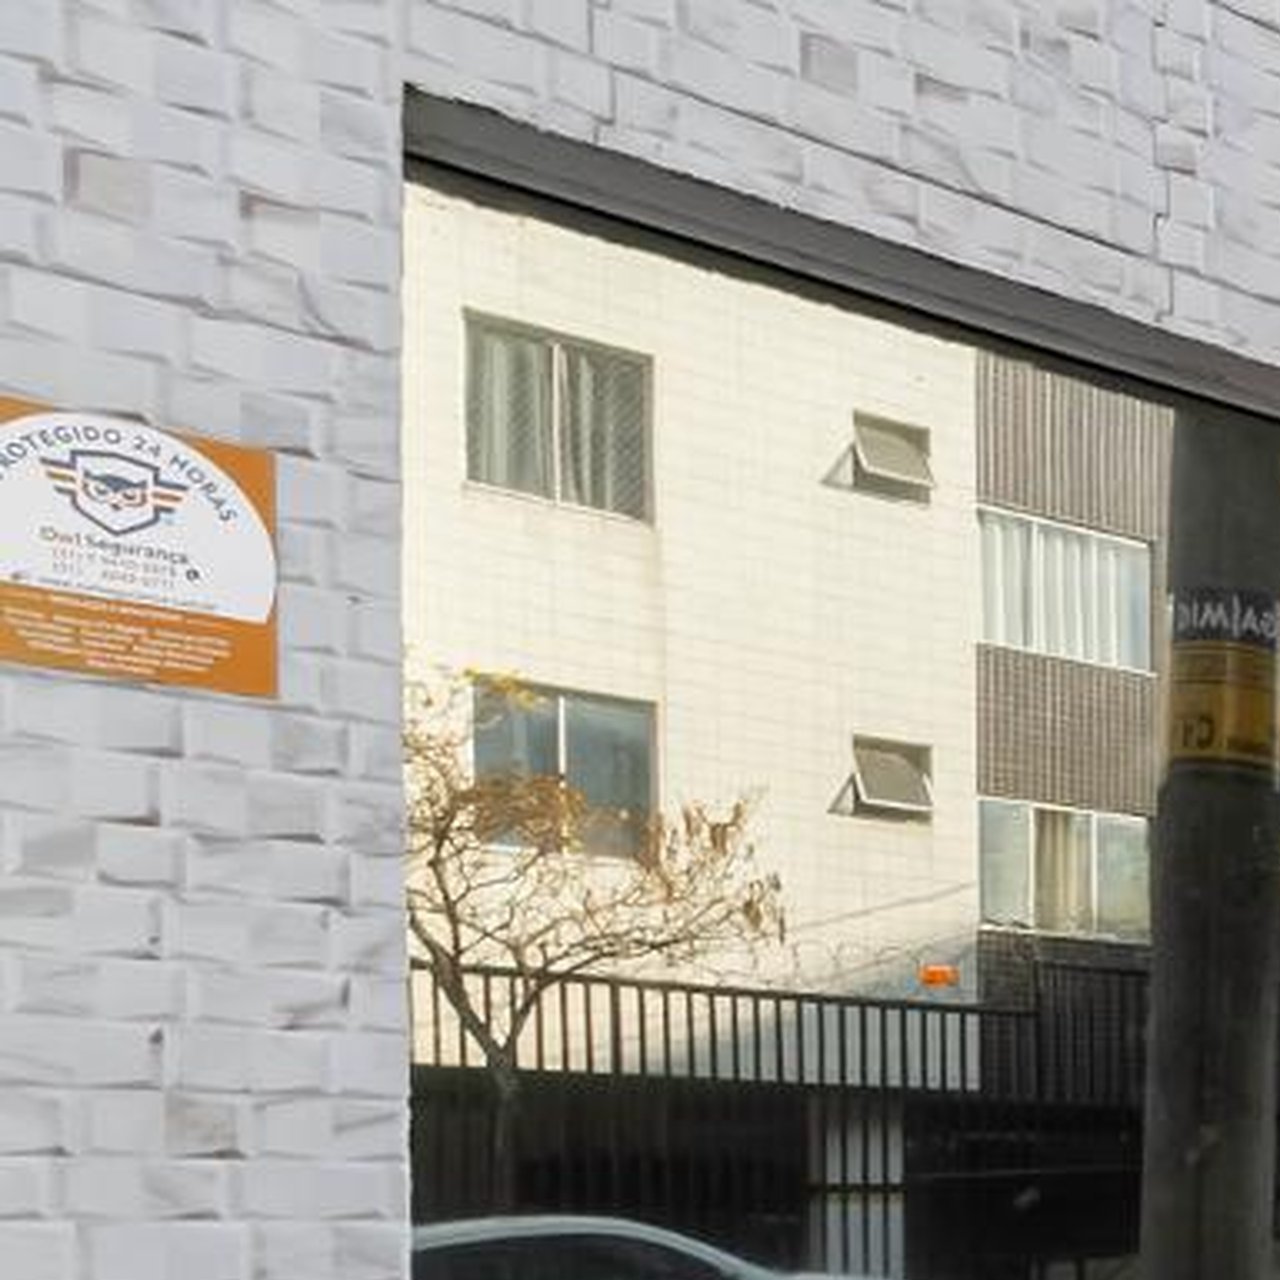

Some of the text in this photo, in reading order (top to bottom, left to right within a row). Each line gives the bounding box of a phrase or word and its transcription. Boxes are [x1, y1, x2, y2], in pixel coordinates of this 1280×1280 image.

[0, 425, 239, 523] ROTEGIDO 24 HORAS
